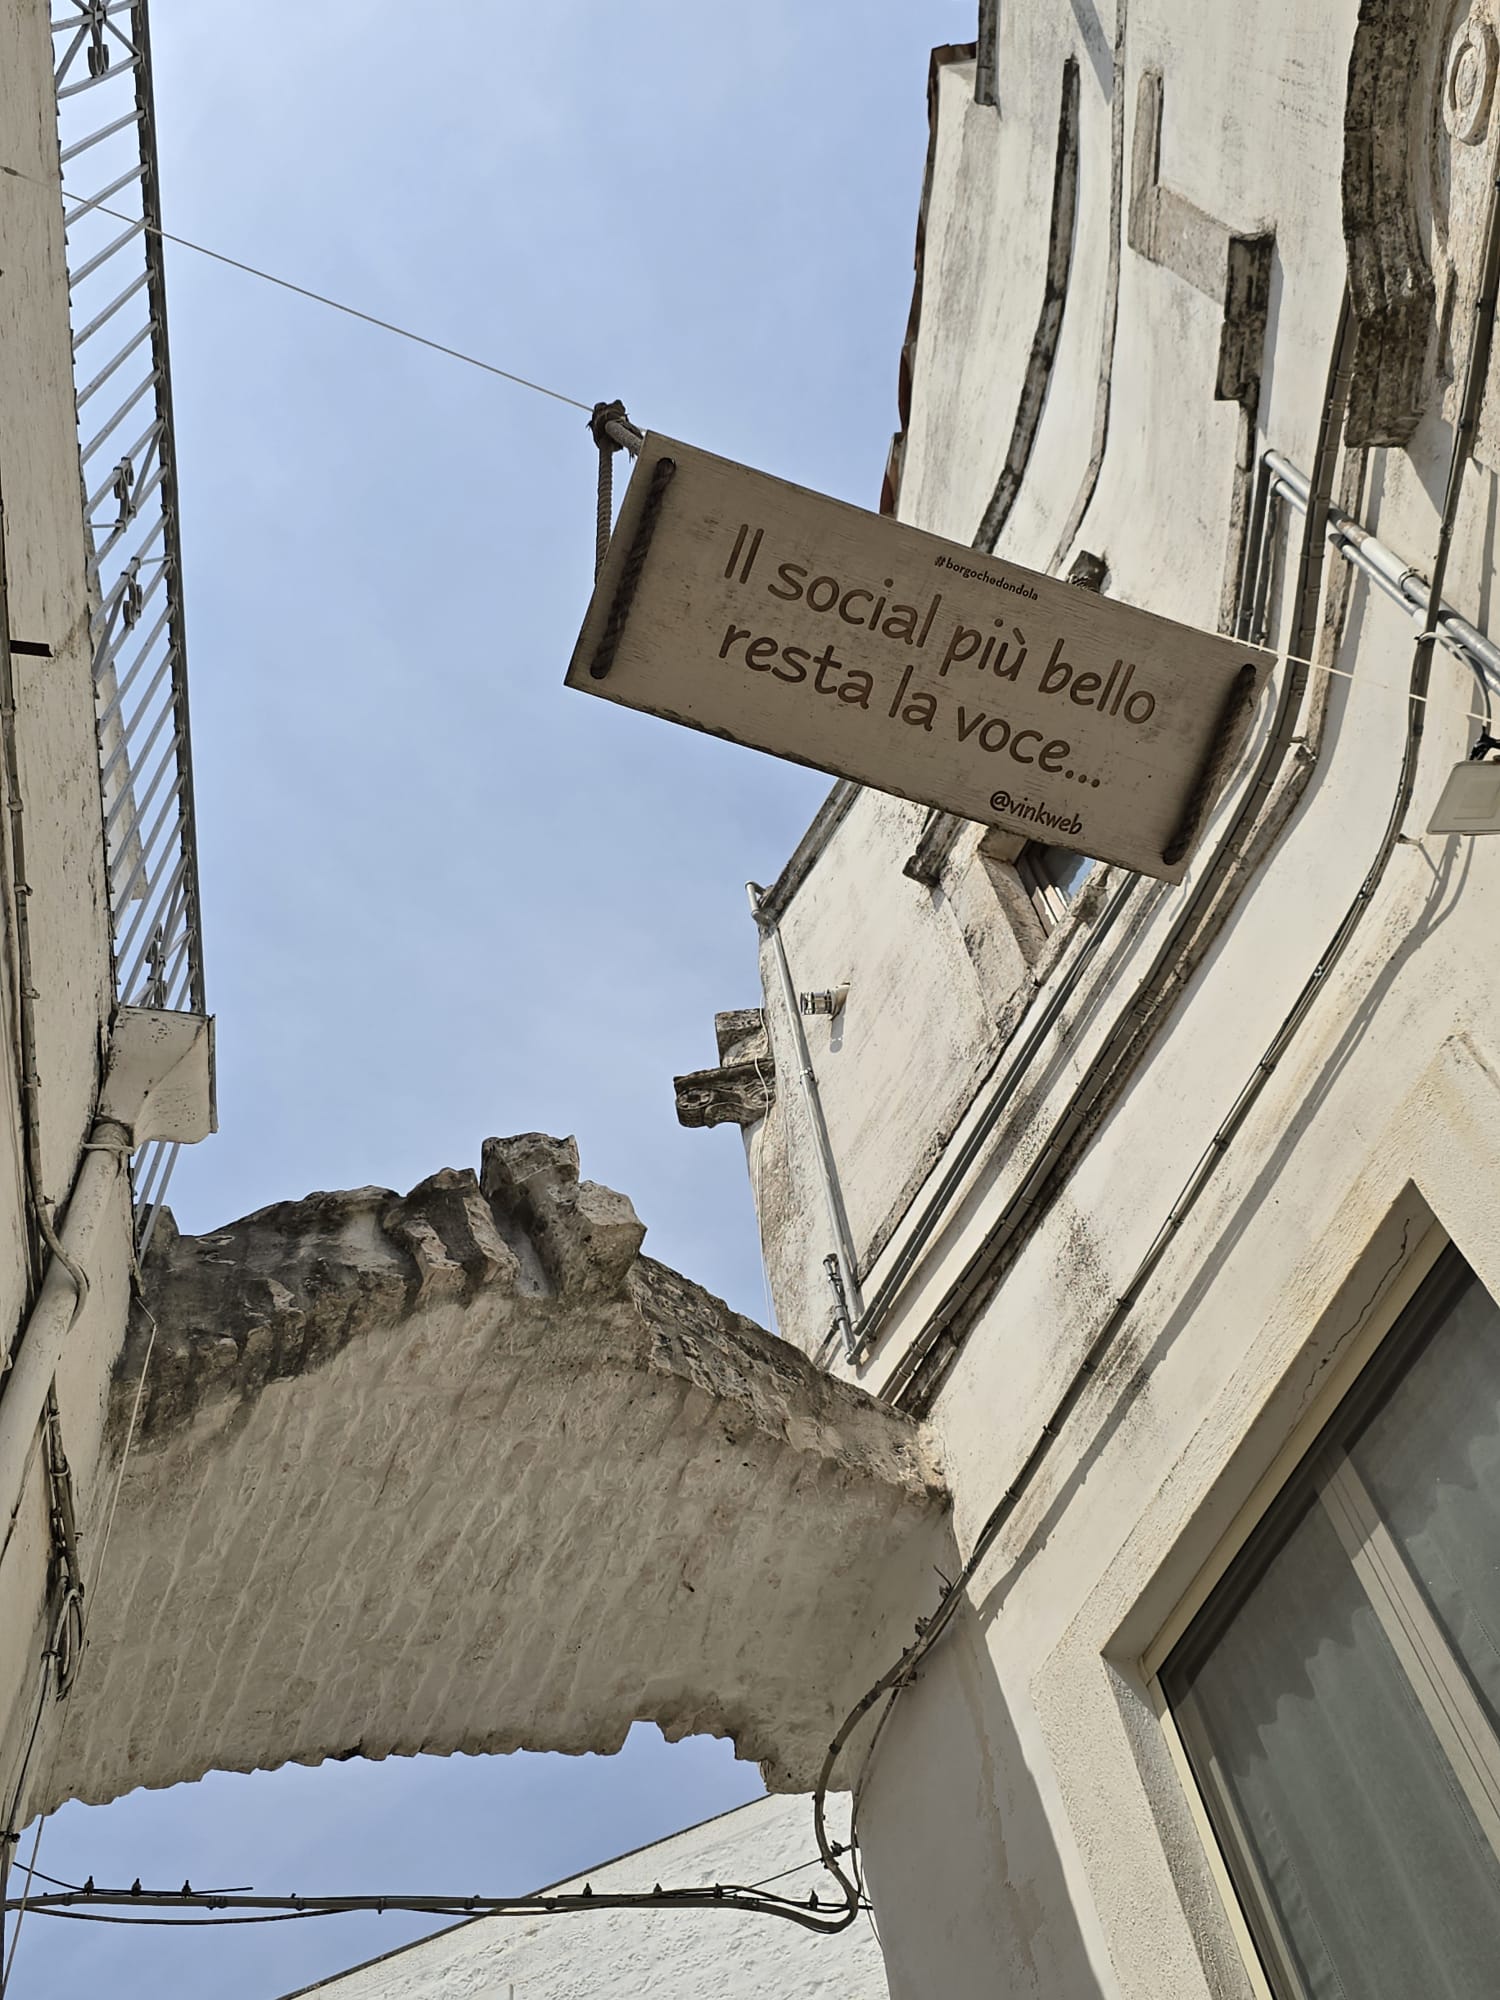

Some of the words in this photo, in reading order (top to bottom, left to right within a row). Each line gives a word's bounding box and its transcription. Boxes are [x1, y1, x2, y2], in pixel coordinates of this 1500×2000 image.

[723, 523, 765, 585] Il
[767, 562, 943, 649] social
[939, 617, 1028, 682] più
[1038, 637, 1156, 725] bello
[934, 555, 1039, 600] #borgochedondola
[718, 623, 874, 710] resta
[888, 664, 938, 733] la
[957, 705, 1101, 789] voce...
[990, 790, 1083, 835] @vinkweb
